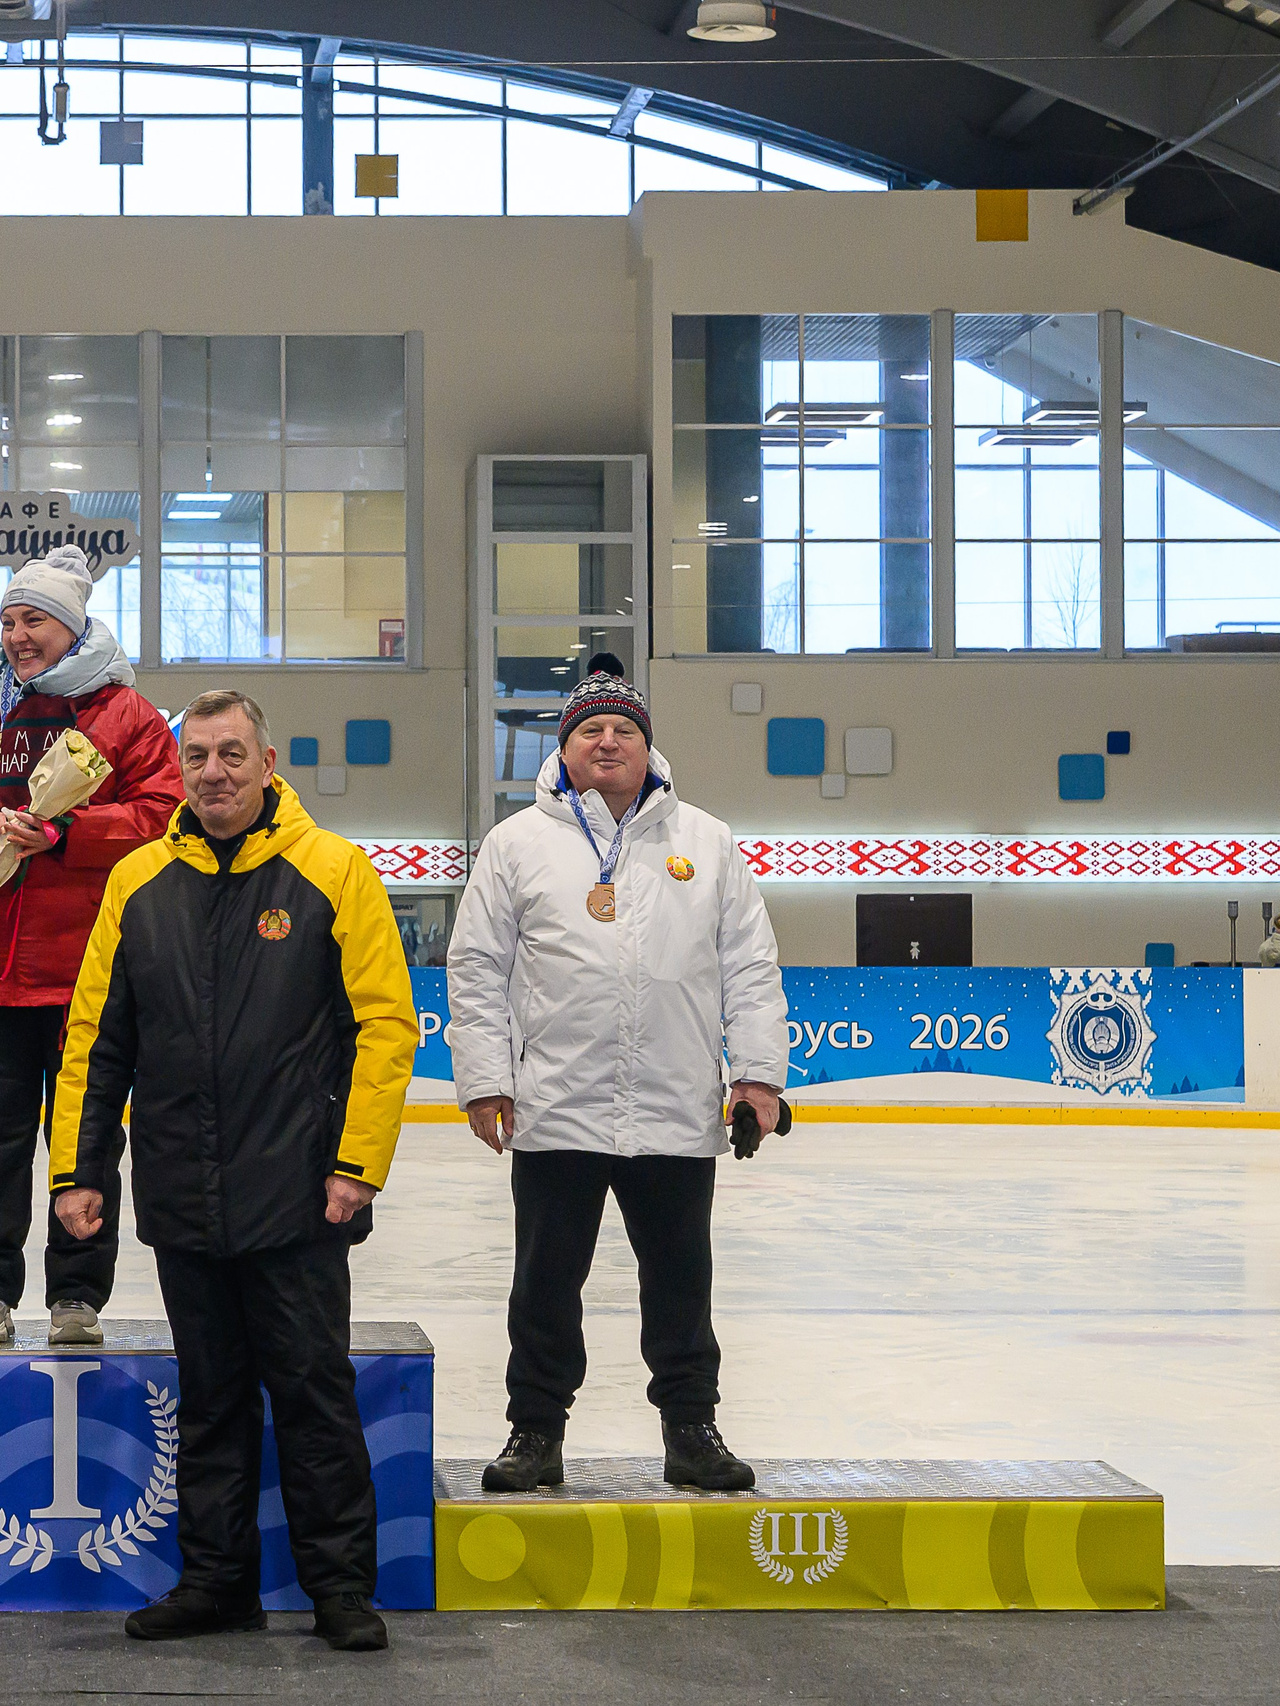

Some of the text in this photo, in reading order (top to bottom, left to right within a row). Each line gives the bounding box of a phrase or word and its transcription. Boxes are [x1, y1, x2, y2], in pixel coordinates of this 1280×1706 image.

[910, 1013, 1009, 1051] 2026
[30, 1361, 101, 1519] I
[766, 1512, 832, 1556] III
